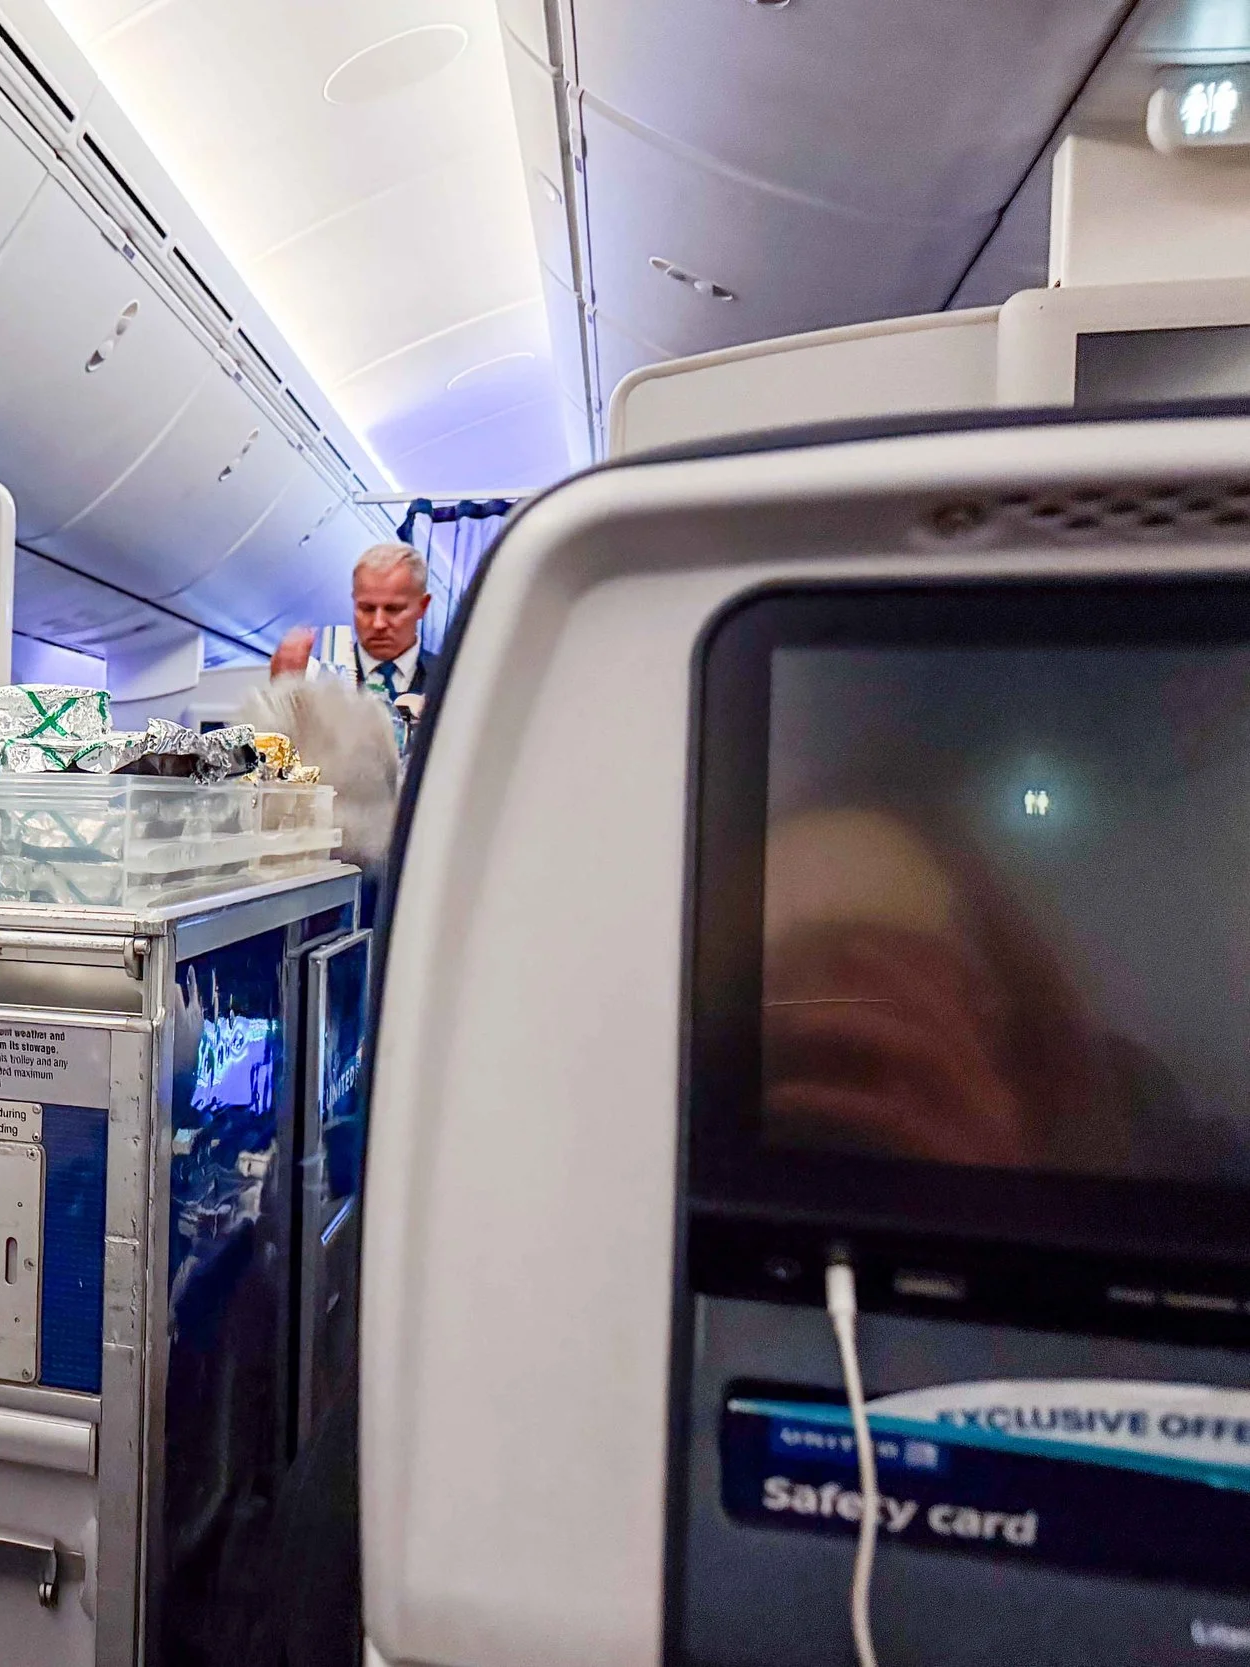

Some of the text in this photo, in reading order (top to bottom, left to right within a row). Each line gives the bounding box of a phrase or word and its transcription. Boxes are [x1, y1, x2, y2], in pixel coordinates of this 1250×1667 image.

[14, 1028, 47, 1040] weather
[50, 1032, 65, 1042] and
[10, 1040, 20, 1050] its
[21, 1042, 59, 1055] stowage.
[10, 1054, 34, 1066] trolley
[36, 1057, 51, 1067] and
[53, 1059, 68, 1070] any
[14, 1069, 54, 1080] maximum
[326, 1066, 355, 1110] UNITED
[927, 1502, 1039, 1548] card
